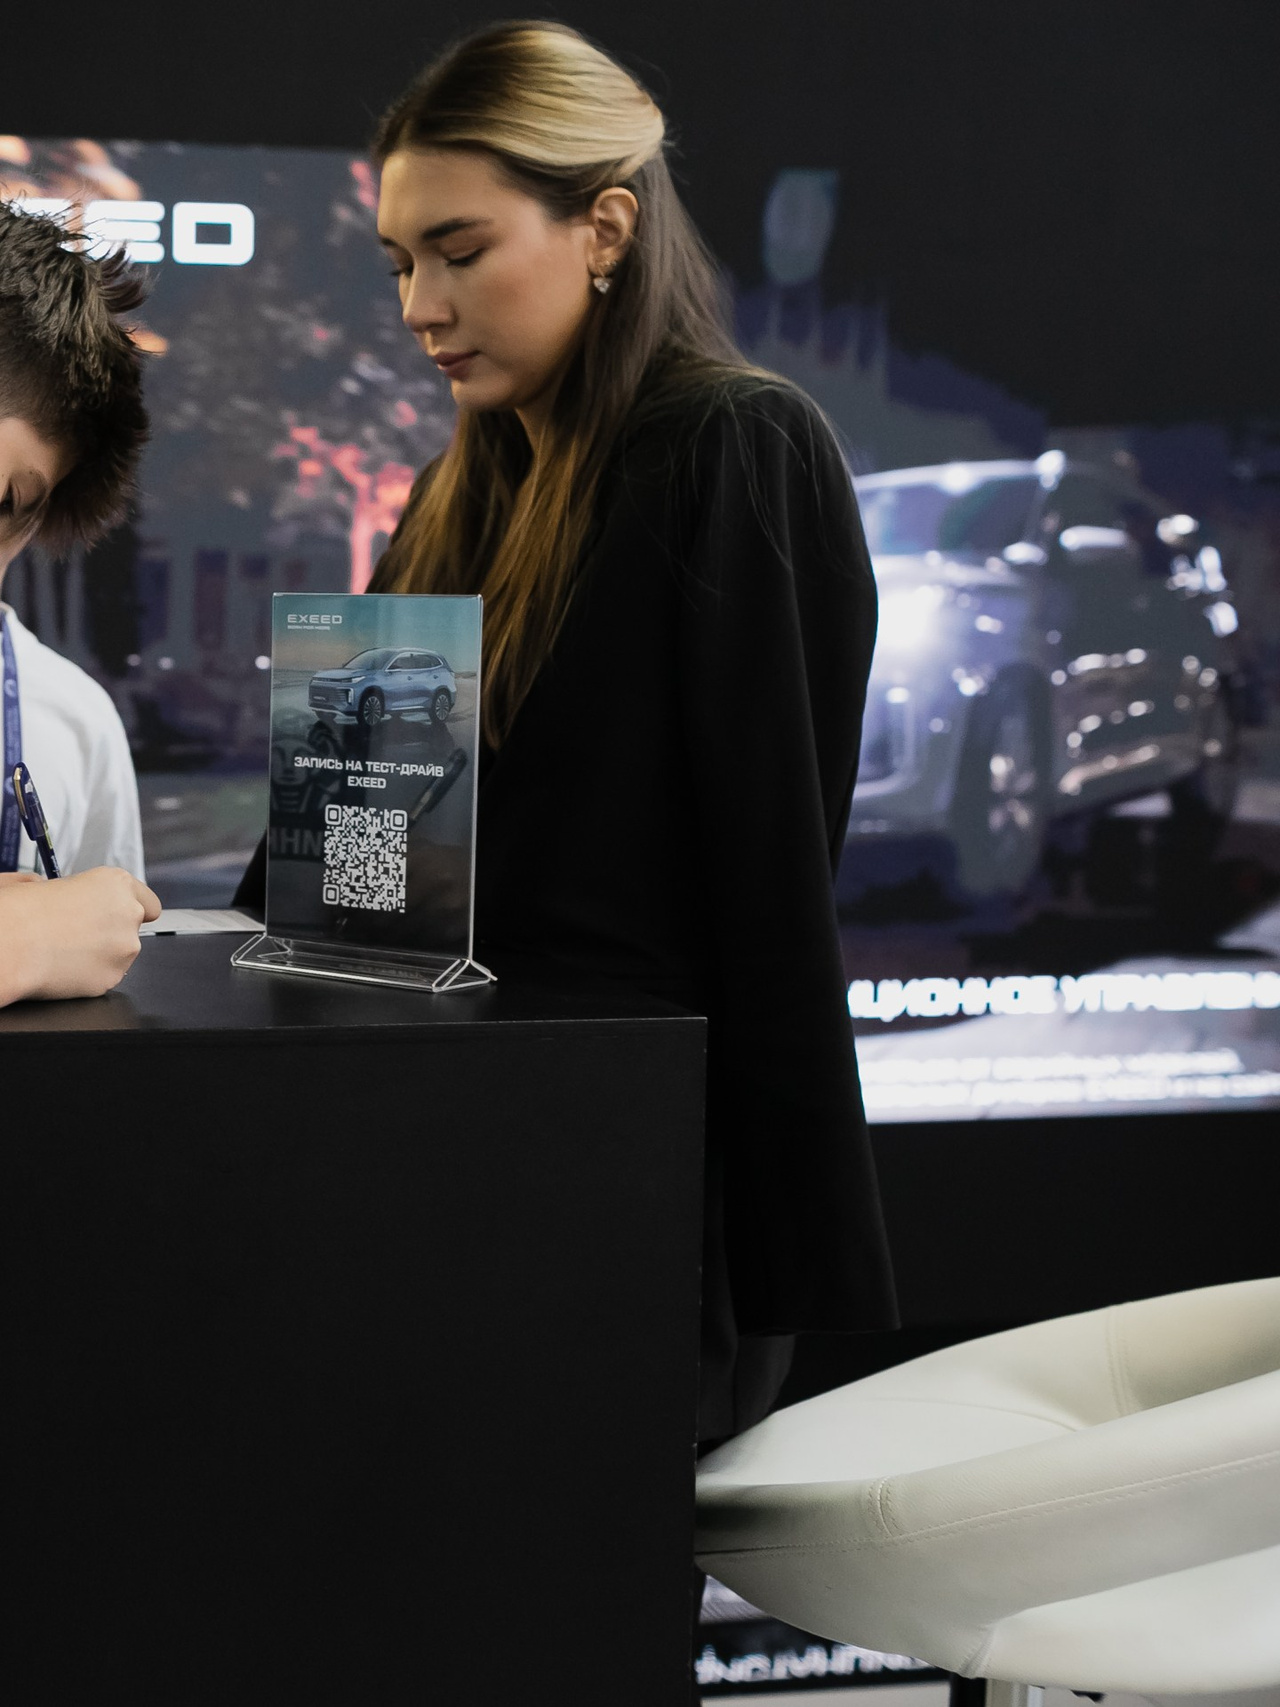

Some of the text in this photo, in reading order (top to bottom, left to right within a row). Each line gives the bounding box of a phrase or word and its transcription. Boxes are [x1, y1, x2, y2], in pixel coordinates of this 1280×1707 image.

[287, 614, 343, 624] EXEED
[294, 757, 444, 777] ЗАПИСЬ НА ТЕСТ-ДРАЙВ
[347, 776, 386, 789] EXEED
